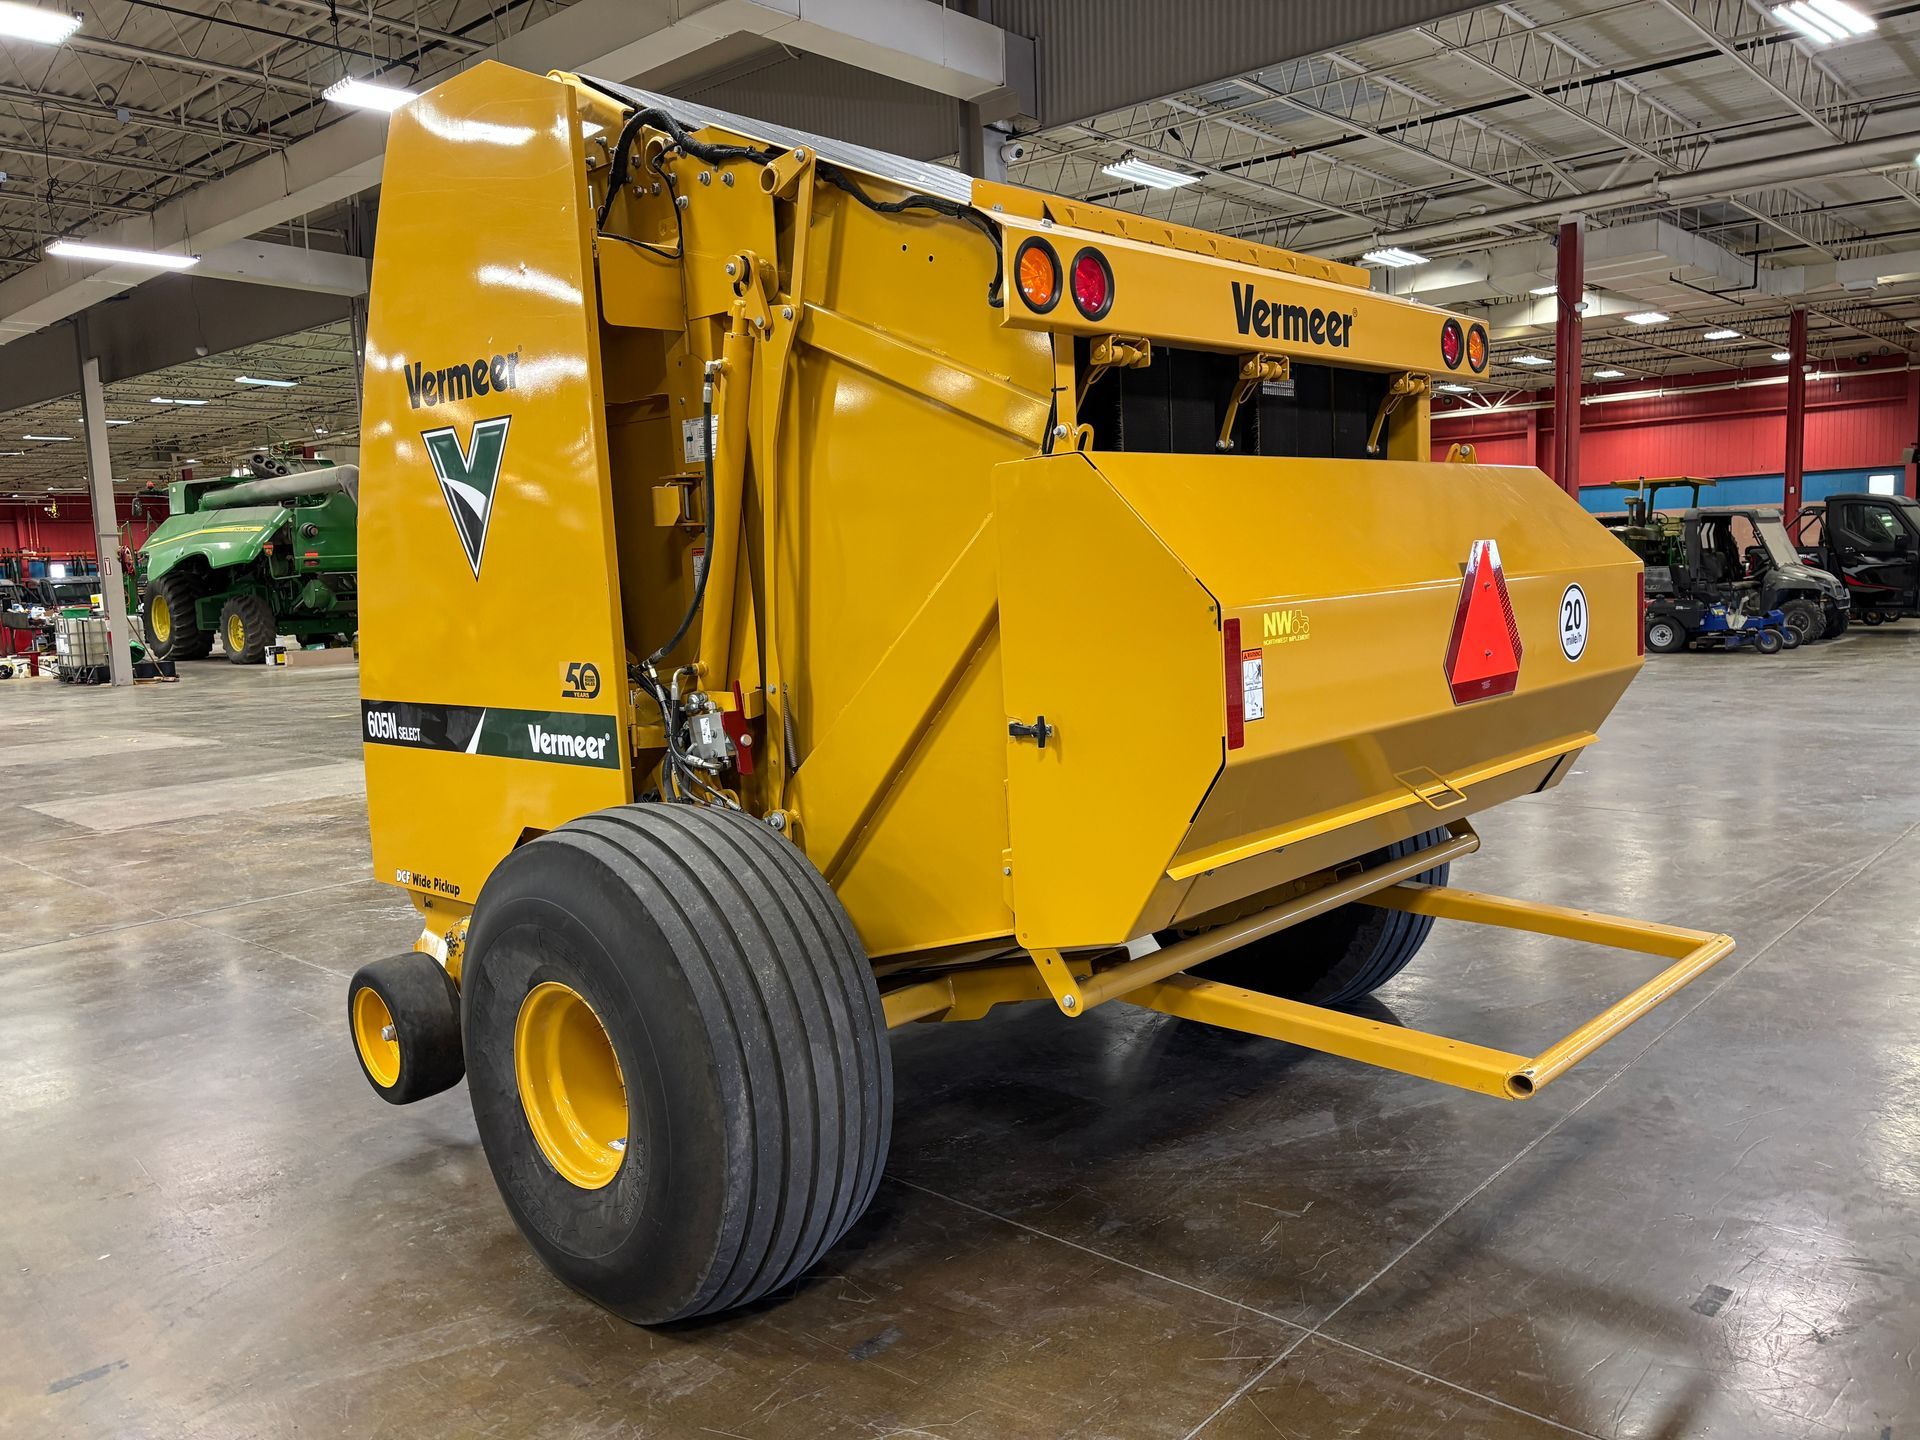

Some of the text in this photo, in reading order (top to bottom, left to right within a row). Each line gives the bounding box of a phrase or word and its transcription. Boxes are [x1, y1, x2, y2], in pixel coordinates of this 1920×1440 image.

[1263, 610, 1292, 637] NW
[1564, 598, 1582, 632] 20
[1565, 631, 1582, 646] mile/h
[563, 662, 600, 696] 50
[367, 710, 421, 742] 605N SELECT
[395, 868, 461, 897] DCF Wide Pickup
